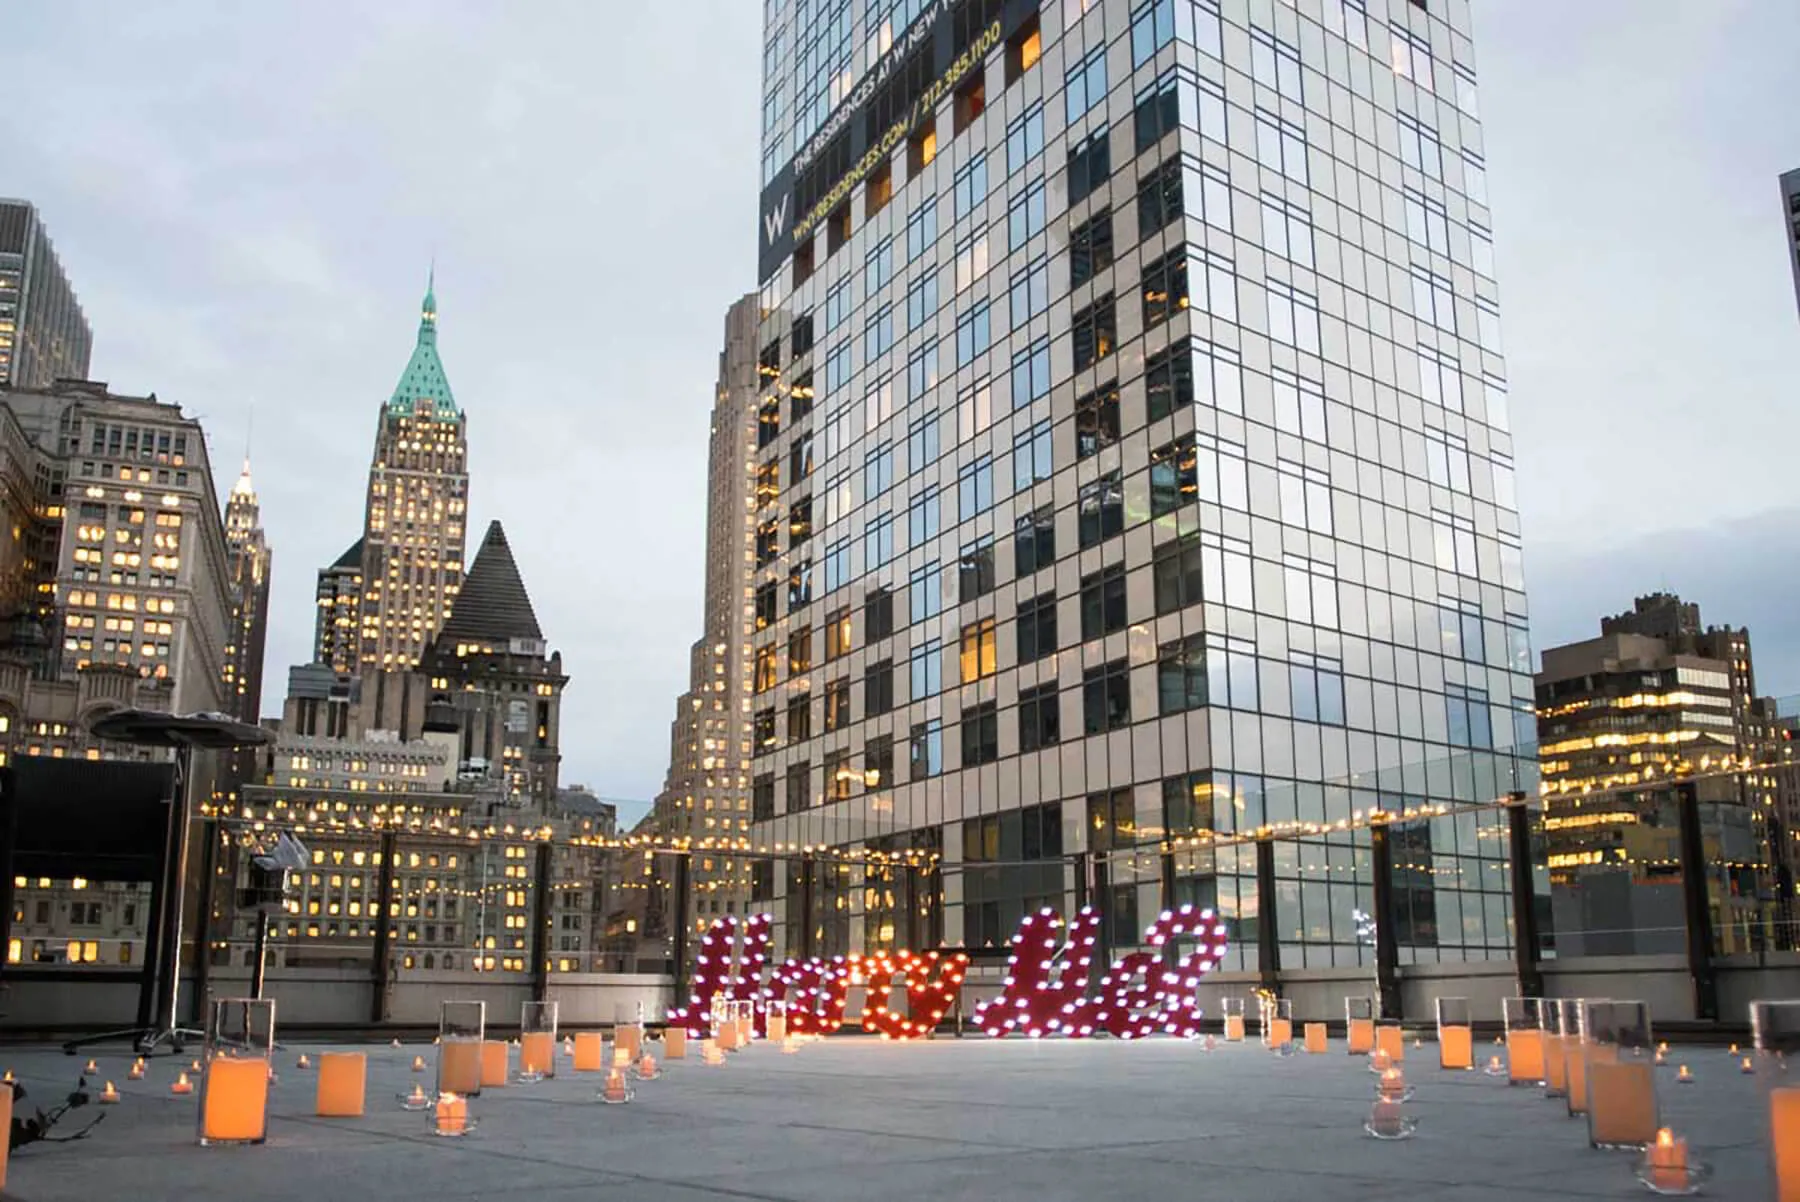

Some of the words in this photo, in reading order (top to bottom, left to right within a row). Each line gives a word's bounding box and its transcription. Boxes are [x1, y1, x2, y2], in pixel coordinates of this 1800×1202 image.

[794, 143, 813, 175] THE
[814, 73, 875, 154] RESIDENCES
[877, 53, 891, 84] AT
[892, 37, 906, 64] W
[908, 1, 939, 50] NEW
[921, 20, 1001, 115] 212.385.1100
[765, 193, 788, 246] W
